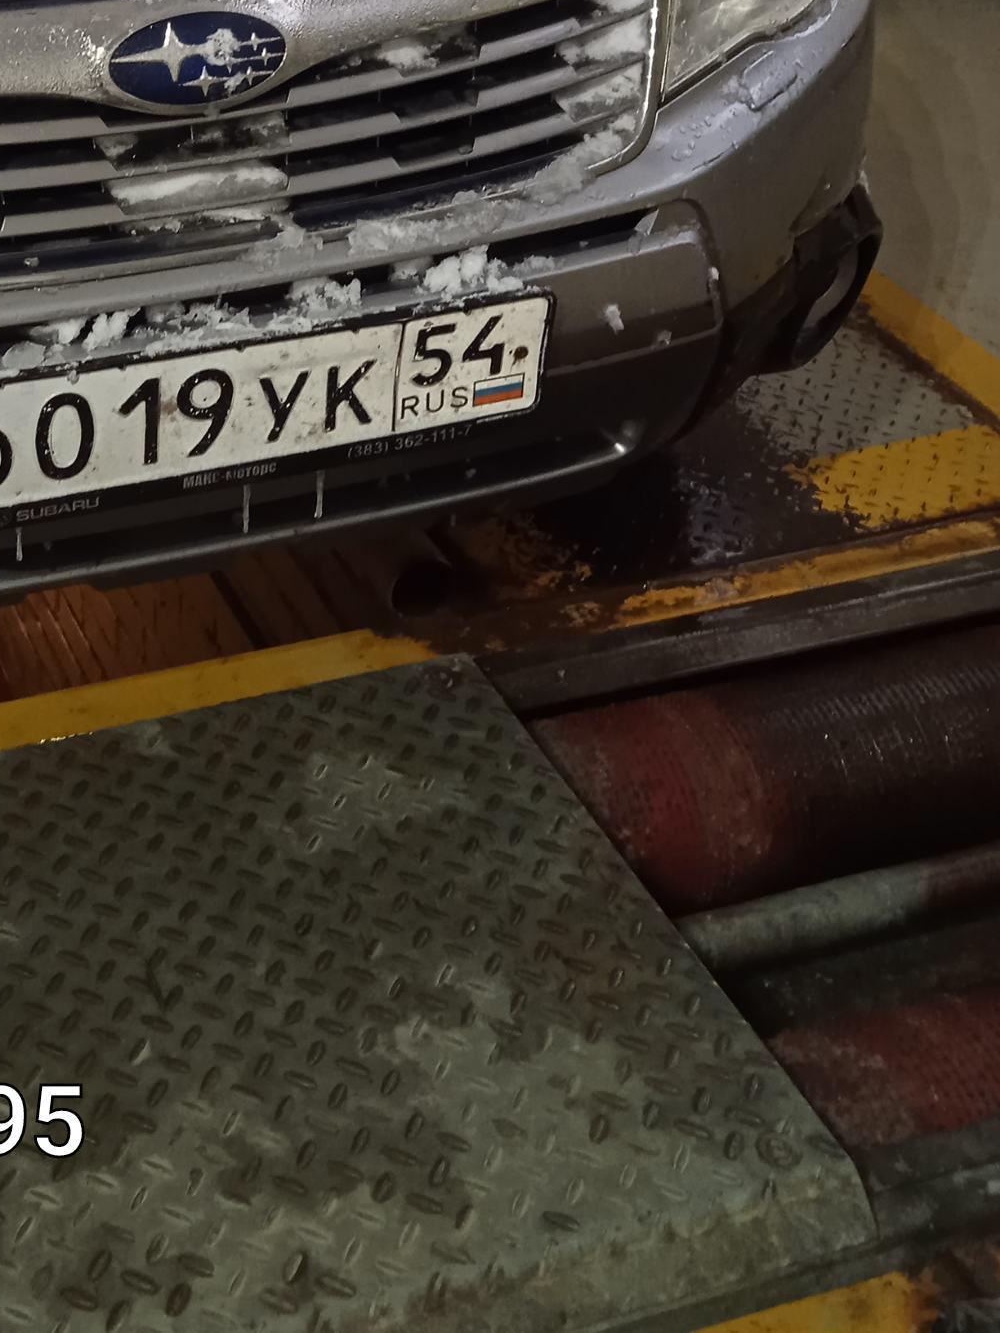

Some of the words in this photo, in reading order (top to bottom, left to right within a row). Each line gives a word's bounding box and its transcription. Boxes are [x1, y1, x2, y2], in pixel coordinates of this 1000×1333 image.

[412, 314, 505, 387] 54
[400, 386, 469, 419] RUS
[346, 440, 389, 459] (383)
[394, 424, 473, 451] 362-111-7
[16, 496, 100, 523] SUBARU
